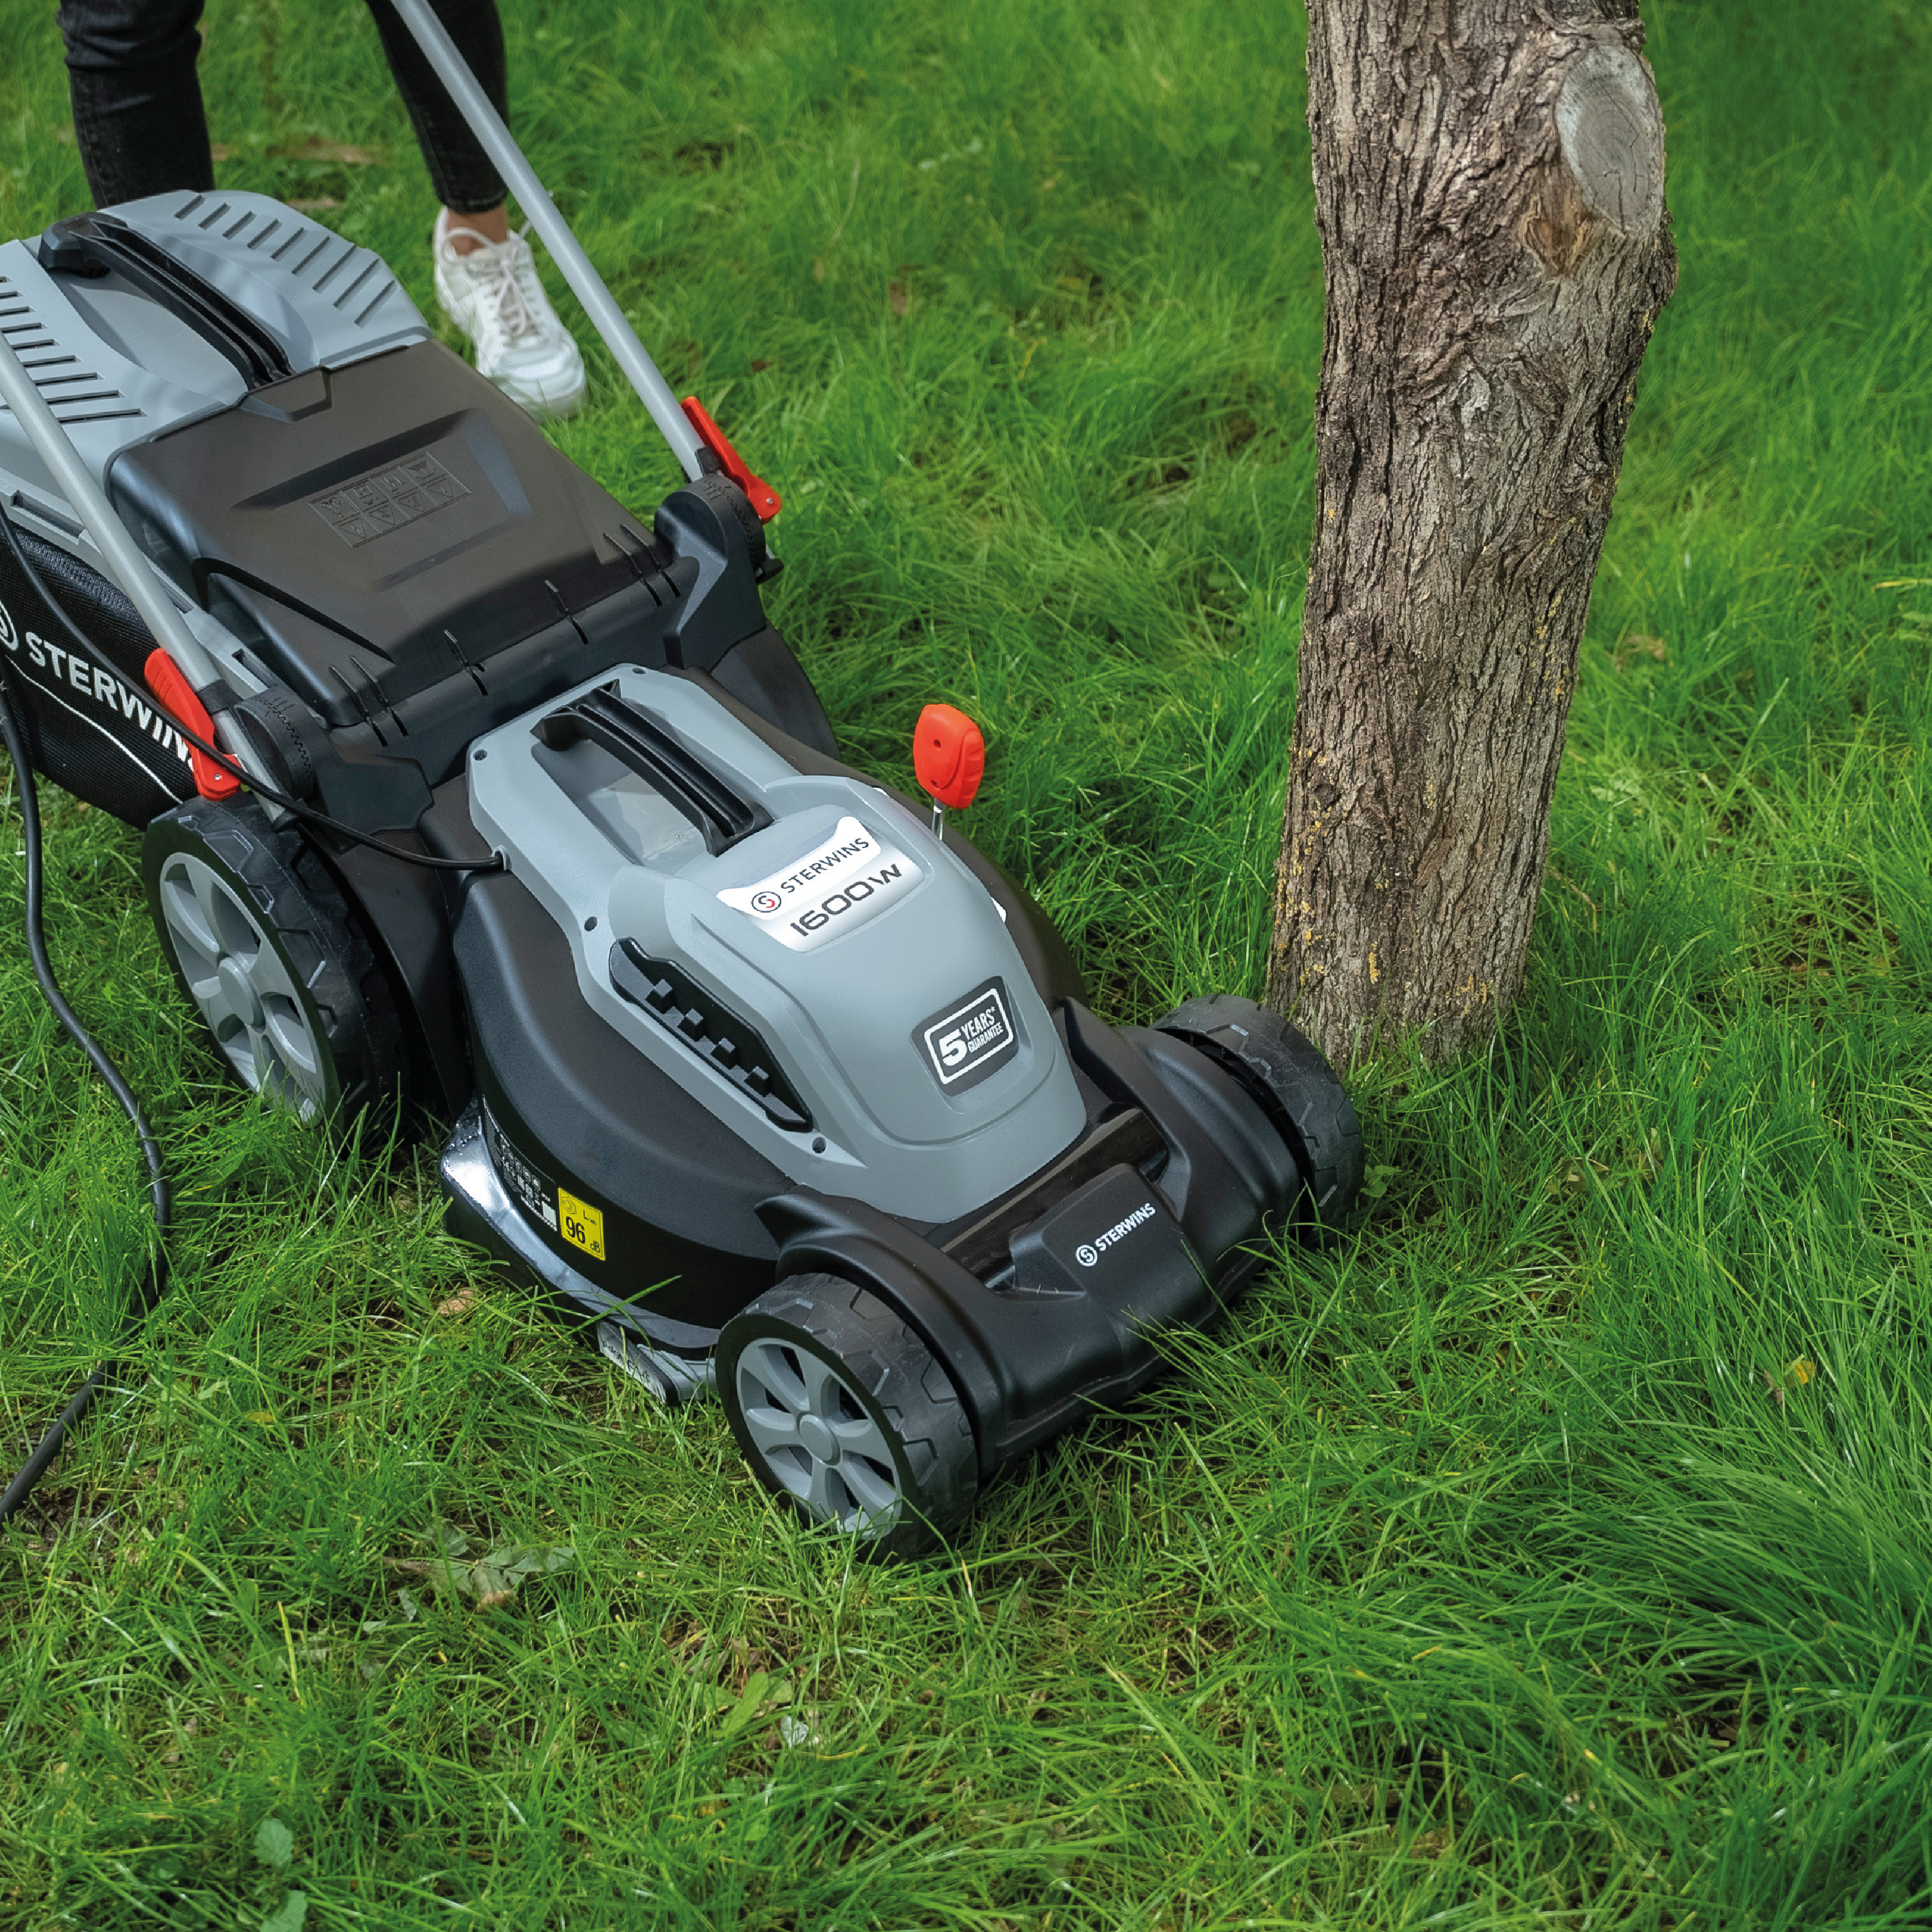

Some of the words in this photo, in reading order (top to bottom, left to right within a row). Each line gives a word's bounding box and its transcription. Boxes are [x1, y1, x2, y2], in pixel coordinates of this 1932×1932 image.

[26, 632, 193, 772] STERWIN
[781, 838, 869, 893] STERWINS
[790, 864, 902, 936] 1600W
[939, 1028, 967, 1066] 5
[967, 1021, 1003, 1053] GUARANTEE
[566, 1216, 585, 1244] 96
[1095, 1203, 1155, 1251] STERWINS
